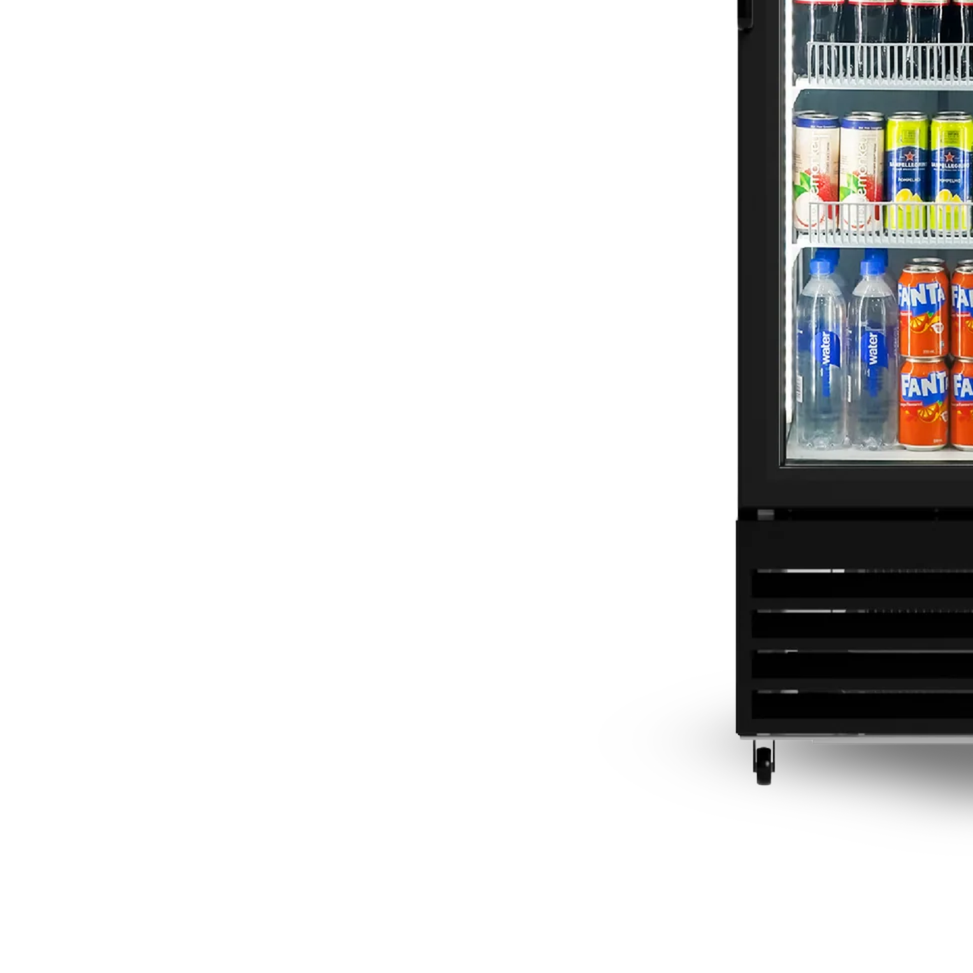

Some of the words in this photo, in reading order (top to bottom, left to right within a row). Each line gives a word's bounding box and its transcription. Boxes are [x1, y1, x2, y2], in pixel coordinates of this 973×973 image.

[898, 282, 945, 307] FANTA
[821, 331, 830, 364] water
[869, 332, 878, 365] water
[901, 372, 948, 397] FANT
